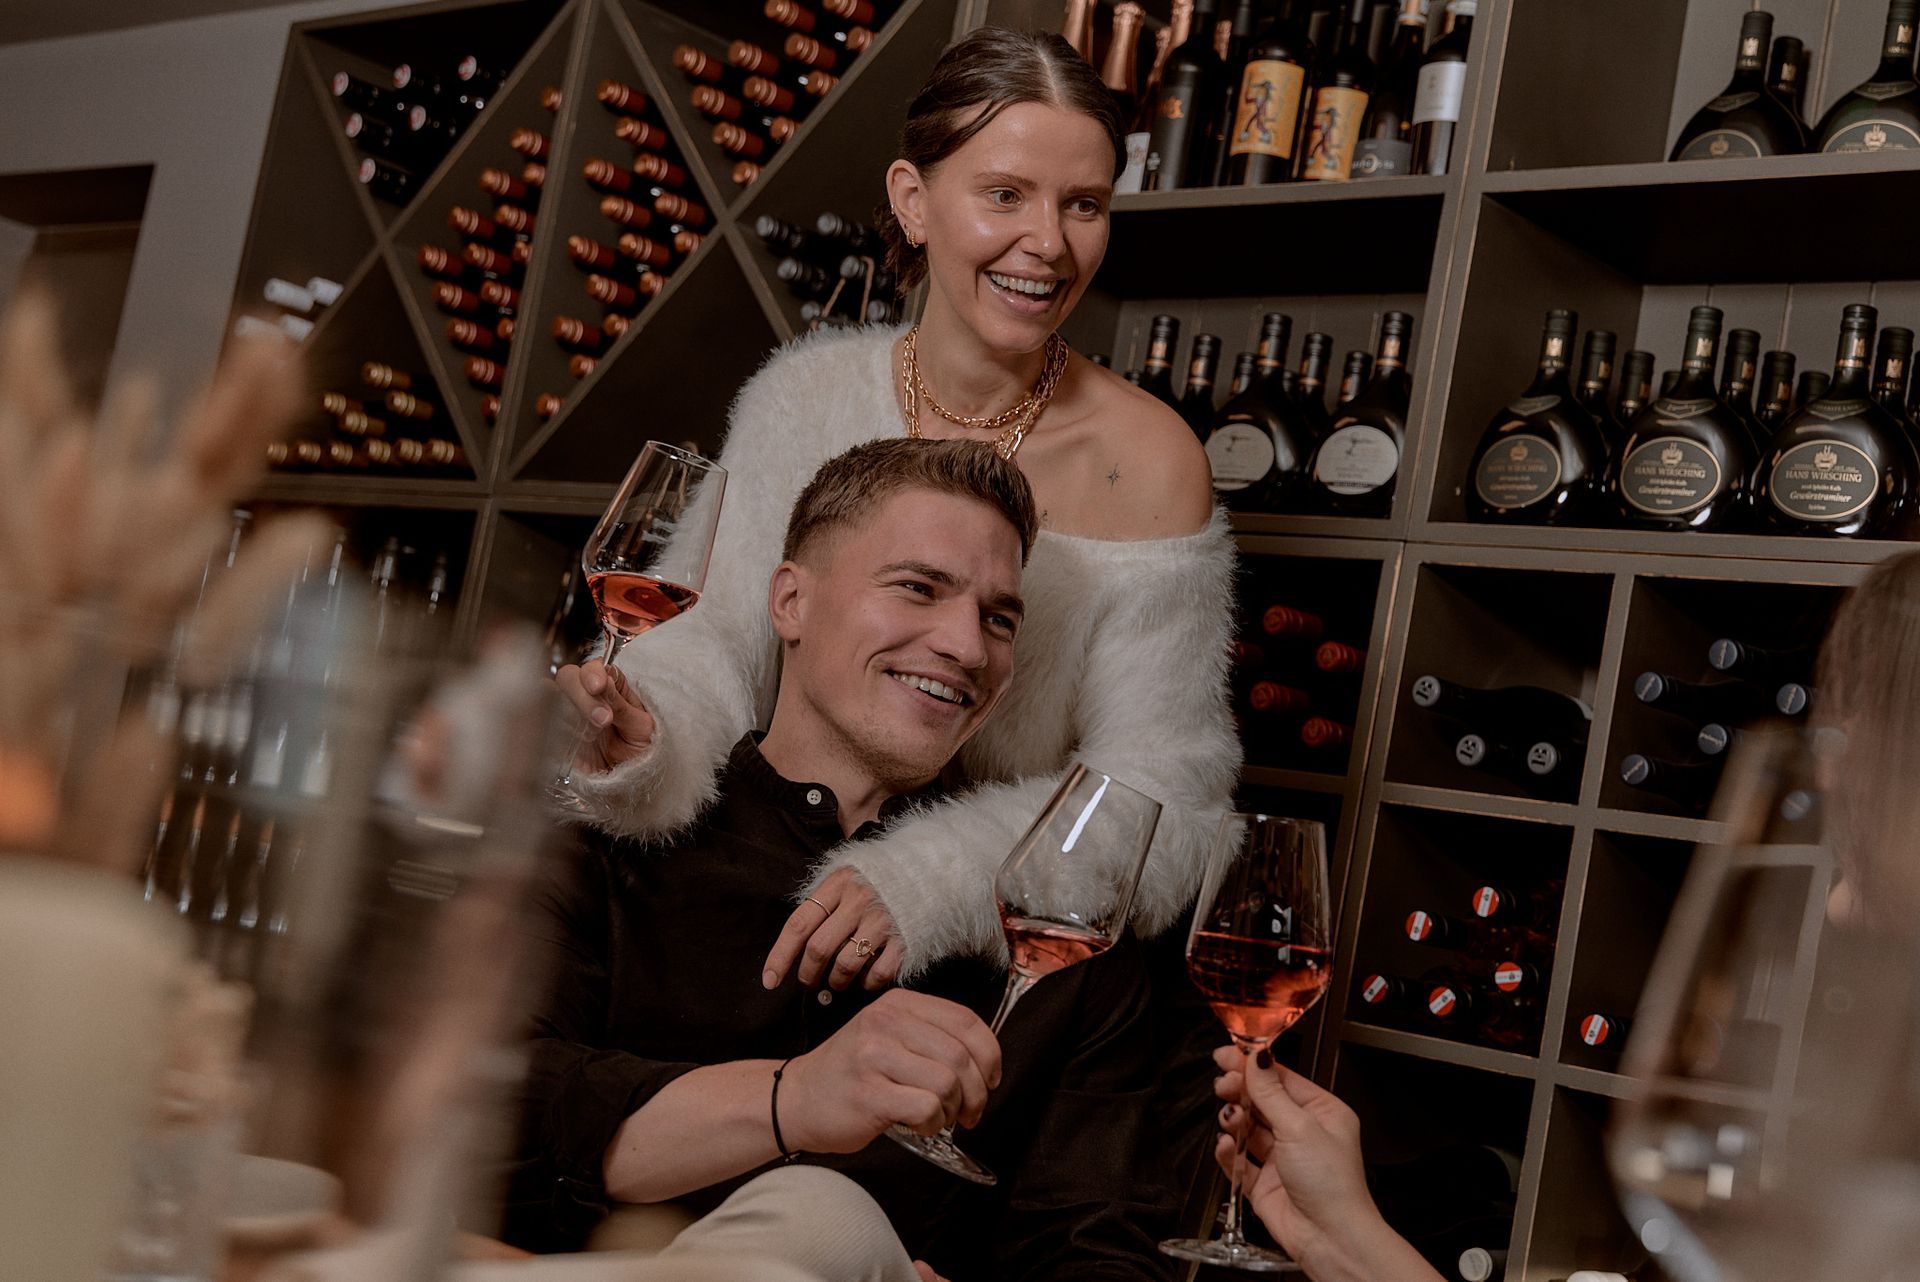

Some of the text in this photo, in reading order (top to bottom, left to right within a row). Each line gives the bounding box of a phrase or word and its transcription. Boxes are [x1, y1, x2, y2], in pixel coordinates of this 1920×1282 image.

[1634, 466, 1706, 478] HANS WIRSCHING
[1785, 470, 1862, 483] HANS WIRSCHING
